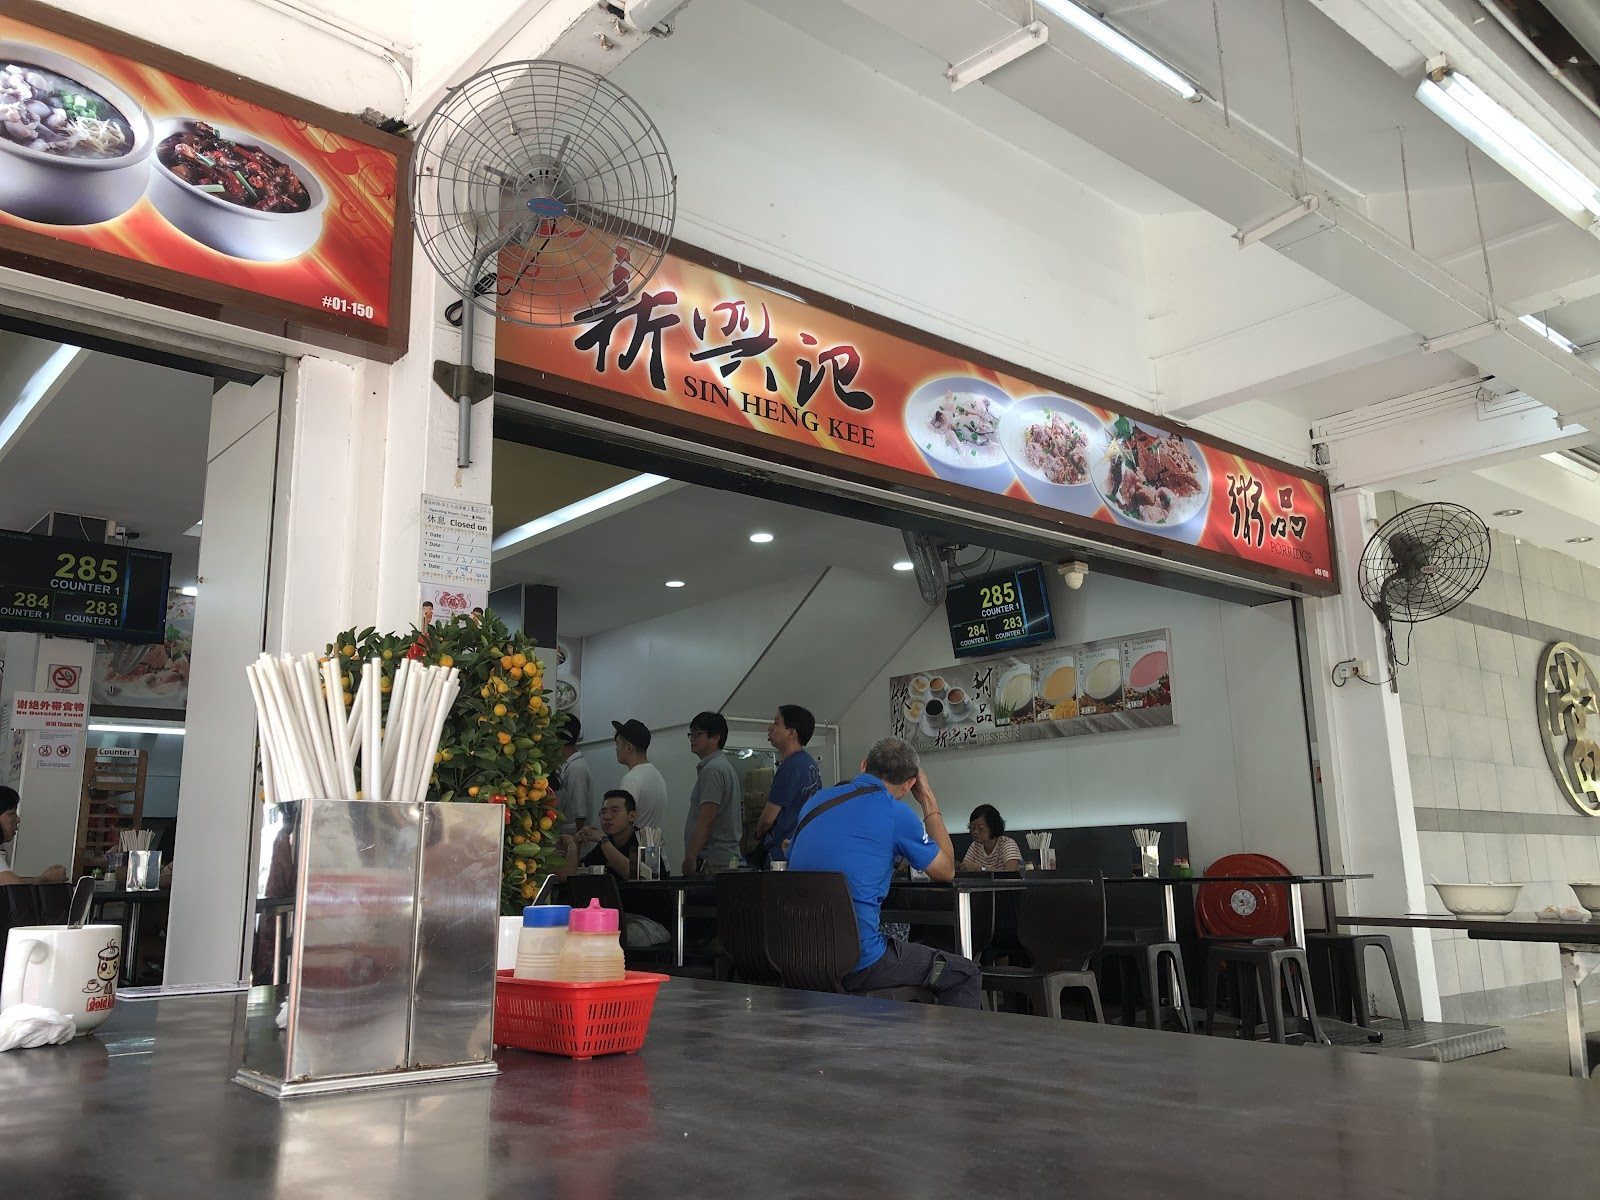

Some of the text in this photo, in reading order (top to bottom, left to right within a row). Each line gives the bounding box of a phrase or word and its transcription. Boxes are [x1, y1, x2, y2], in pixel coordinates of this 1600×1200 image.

[321, 295, 374, 319] #01-150
[684, 375, 876, 449] SIN HENG KEE
[450, 519, 476, 530] Closed
[1270, 541, 1314, 564] PORRIDGE
[55, 552, 119, 584] 285
[50, 578, 120, 596] COUNTER 1
[13, 591, 50, 609] 284
[979, 581, 1016, 609] 285
[0, 606, 50, 620] OUNTER 1
[85, 599, 119, 617] 283
[981, 603, 1021, 618] COUNTER 1
[64, 613, 119, 627] COUNTER 1
[1003, 616, 1023, 630] 283
[967, 623, 987, 638] 284
[995, 630, 1021, 640] COUNTER
[960, 636, 985, 647] COUNTER
[977, 729, 1021, 743] DESSERTS
[99, 748, 131, 757] Counter
